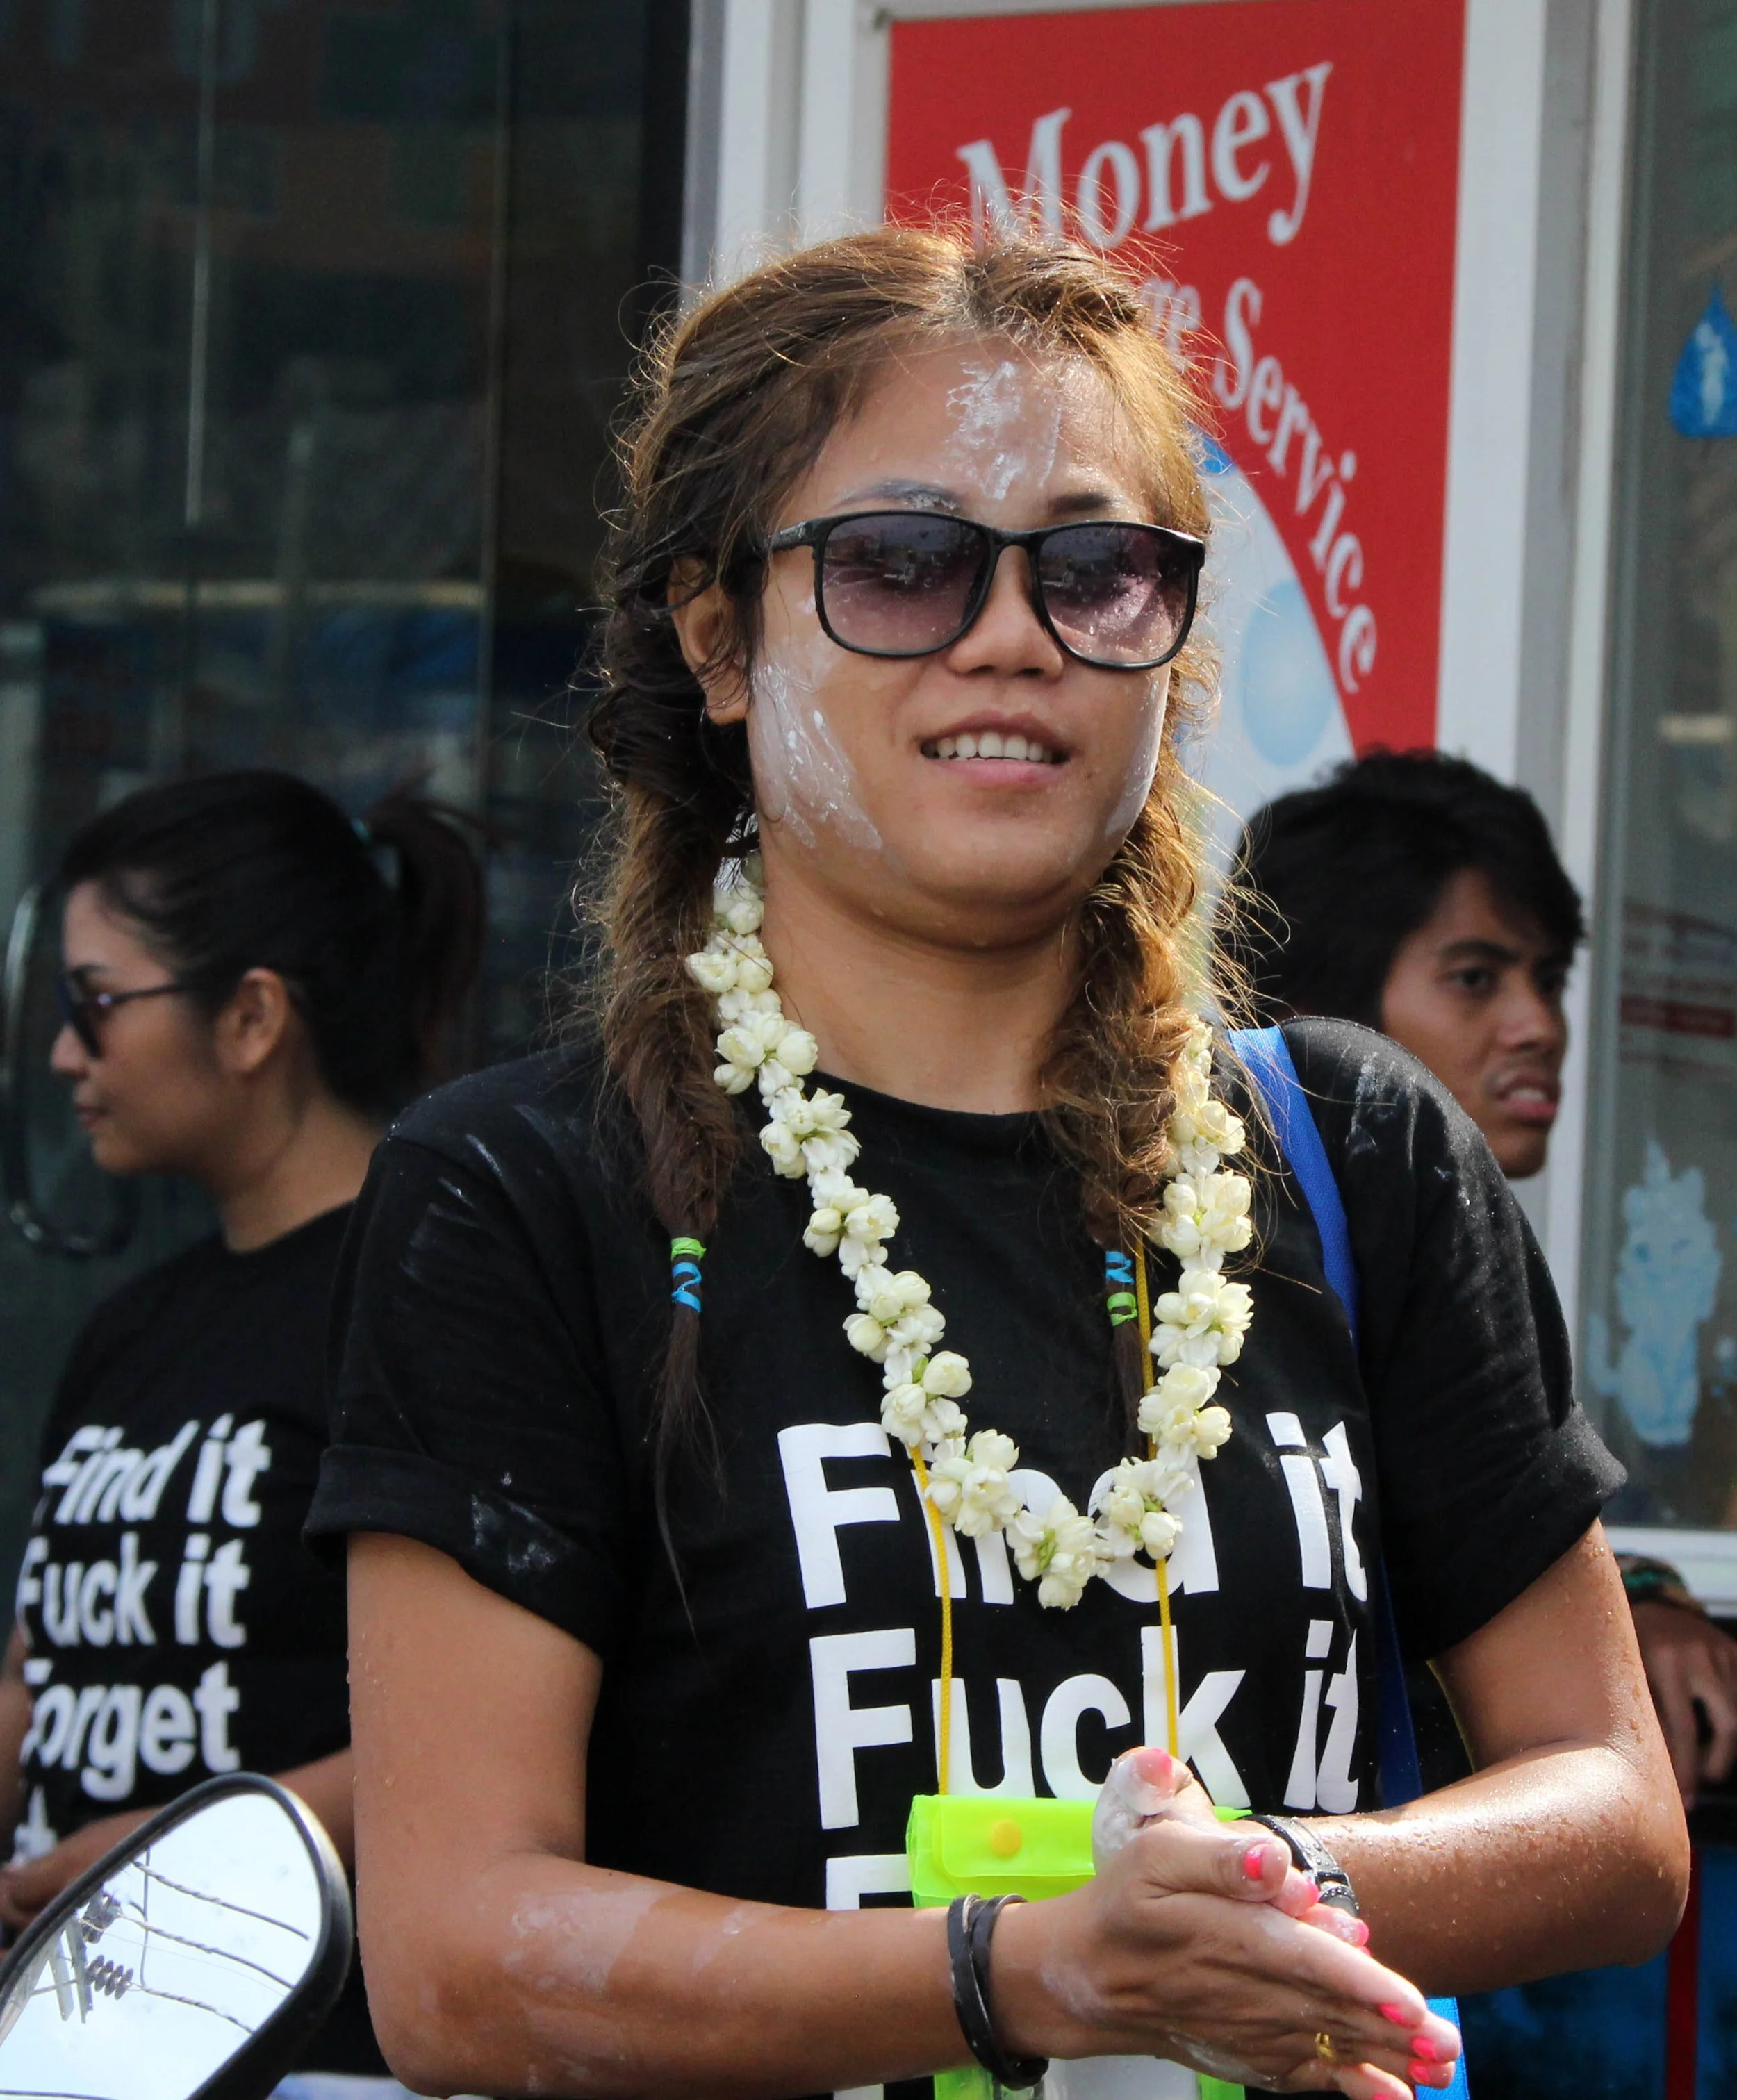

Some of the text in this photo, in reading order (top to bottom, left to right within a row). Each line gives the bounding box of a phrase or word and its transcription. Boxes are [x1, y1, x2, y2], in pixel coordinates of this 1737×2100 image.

[955, 60, 1333, 251] Money
[1212, 276, 1377, 694] Service
[35, 1413, 272, 1528] Find it
[1265, 1411, 1369, 1603] it
[15, 1531, 251, 1650] Fuck it
[809, 1619, 1359, 1830] Fuck it
